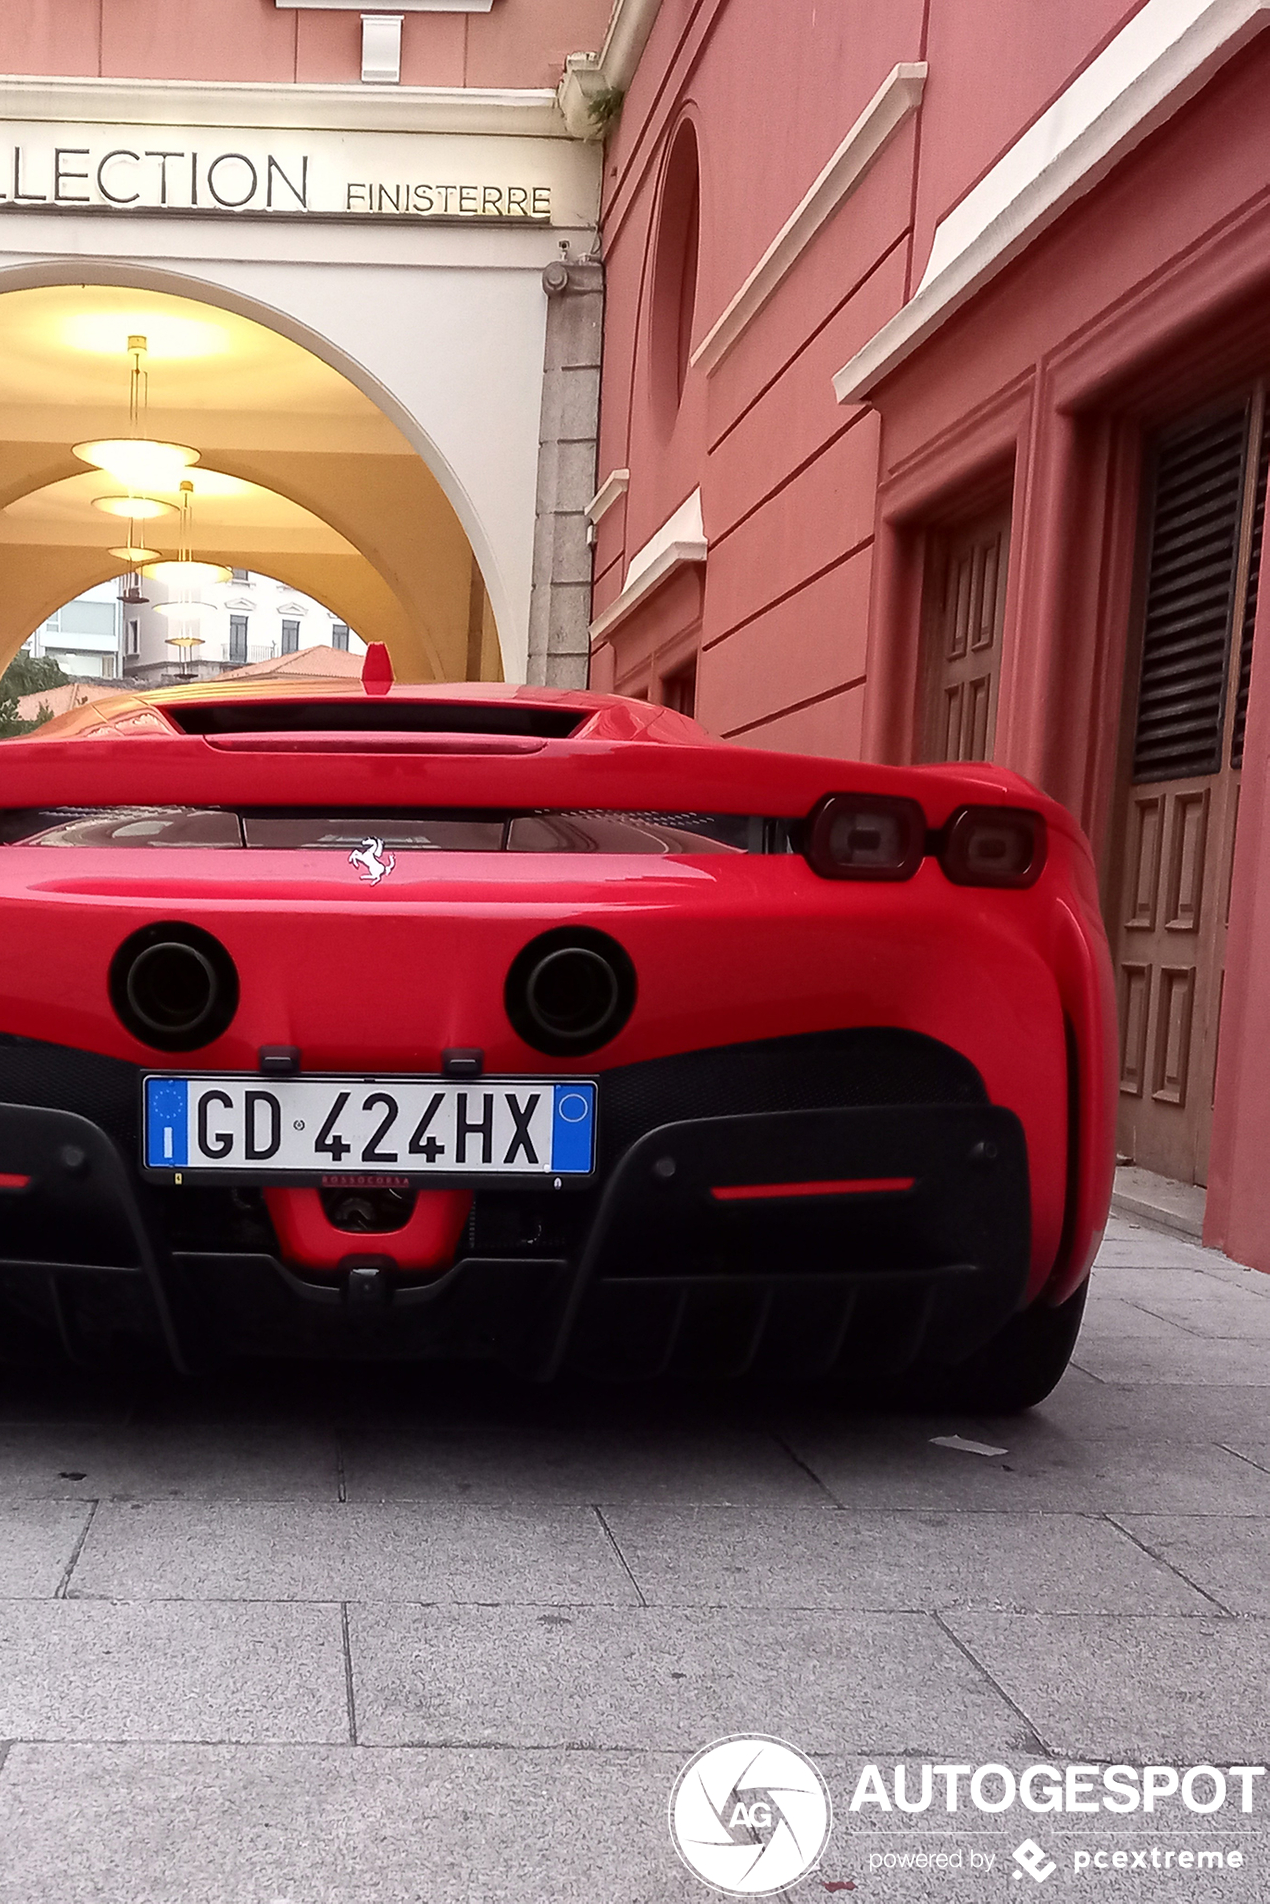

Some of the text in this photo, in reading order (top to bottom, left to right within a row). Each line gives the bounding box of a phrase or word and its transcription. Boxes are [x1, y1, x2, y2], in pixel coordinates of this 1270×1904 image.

[346, 182, 552, 216] FINISTERRE
[197, 1089, 541, 1164] GD 424HX
